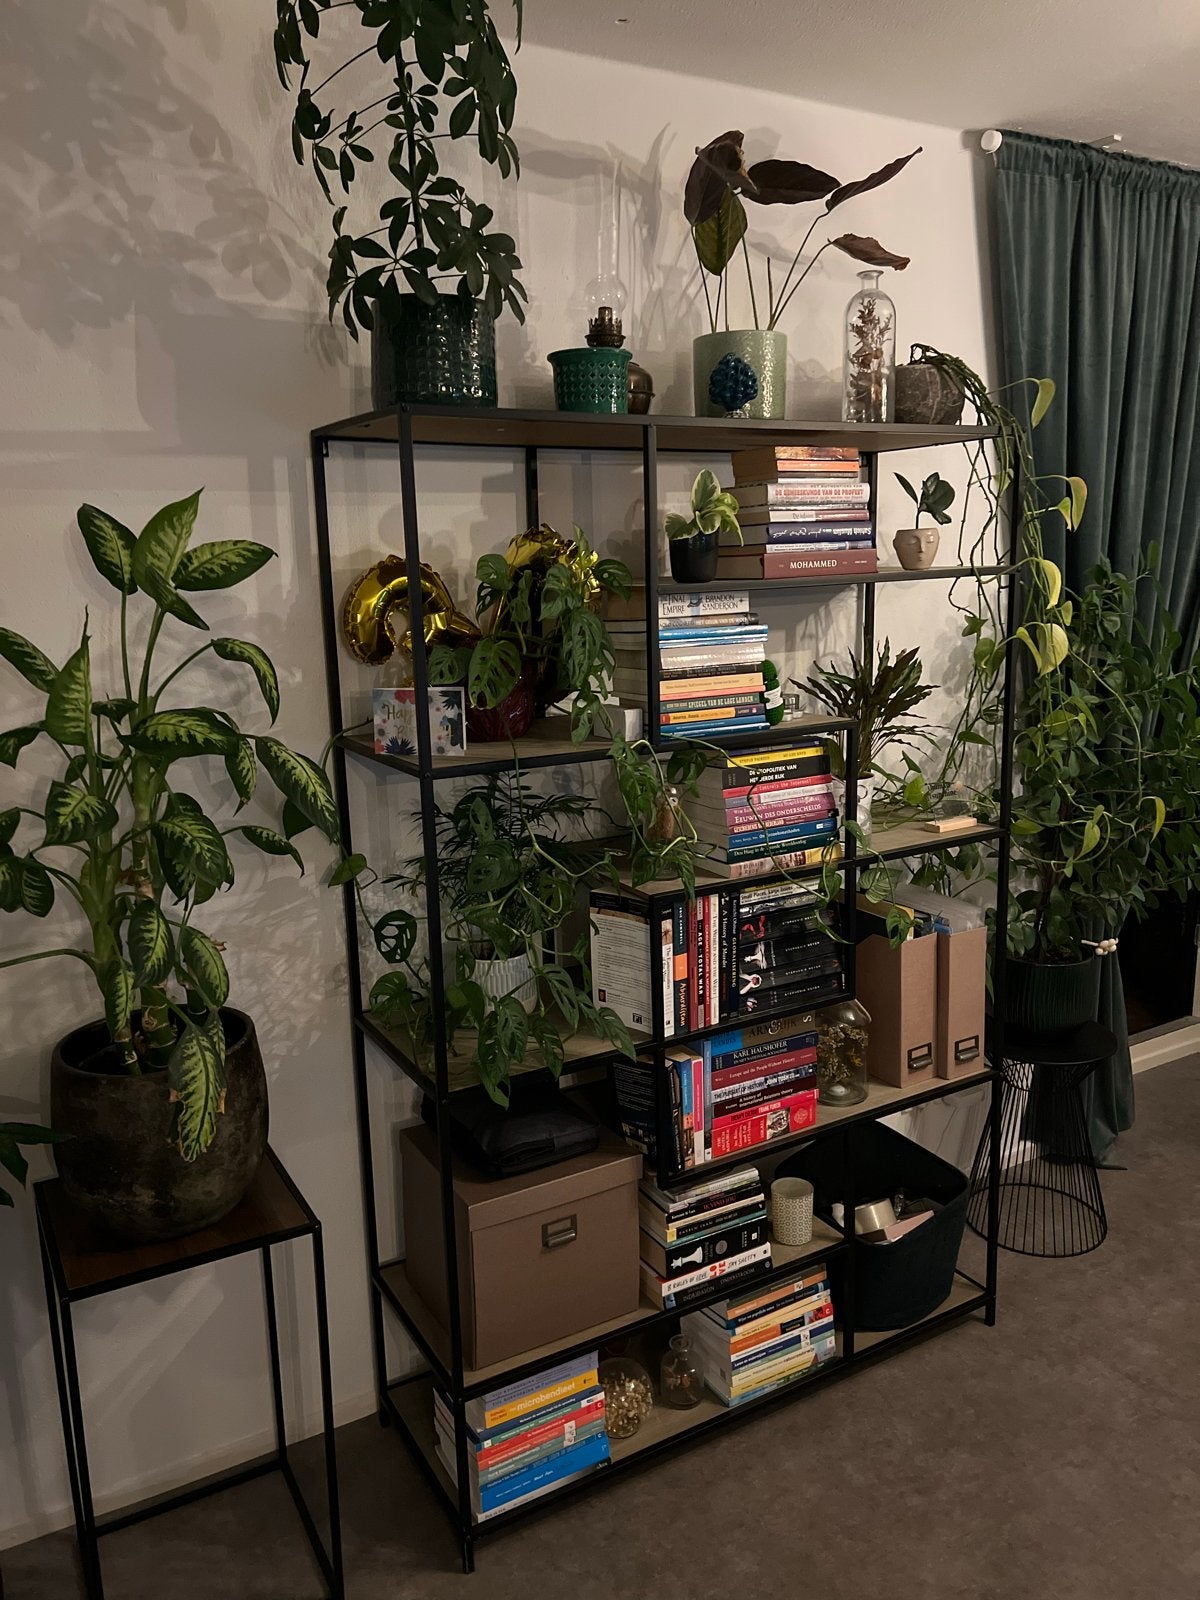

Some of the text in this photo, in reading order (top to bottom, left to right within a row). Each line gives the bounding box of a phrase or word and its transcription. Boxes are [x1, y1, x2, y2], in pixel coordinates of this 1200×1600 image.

[790, 560, 837, 569] MOHAMMED
[668, 594, 685, 605] FINAL
[706, 594, 734, 602] BRANDON
[663, 603, 685, 615] EMPIRE
[702, 602, 738, 610] SANDERSON
[764, 810, 775, 818] DES
[776, 804, 821, 817] ONDERSCHEIDS
[678, 983, 686, 1026] Absurdistan
[733, 1041, 787, 1059] KARL HAUSHOFER
[766, 1077, 778, 1085] JOHN
[723, 1088, 740, 1097] PURSUIT
[748, 1082, 764, 1090] HISTORY
[740, 1098, 763, 1107] International
[738, 1254, 756, 1264] SHETTY
[673, 1280, 688, 1289] RULES
[517, 1383, 576, 1411] microbendieet
